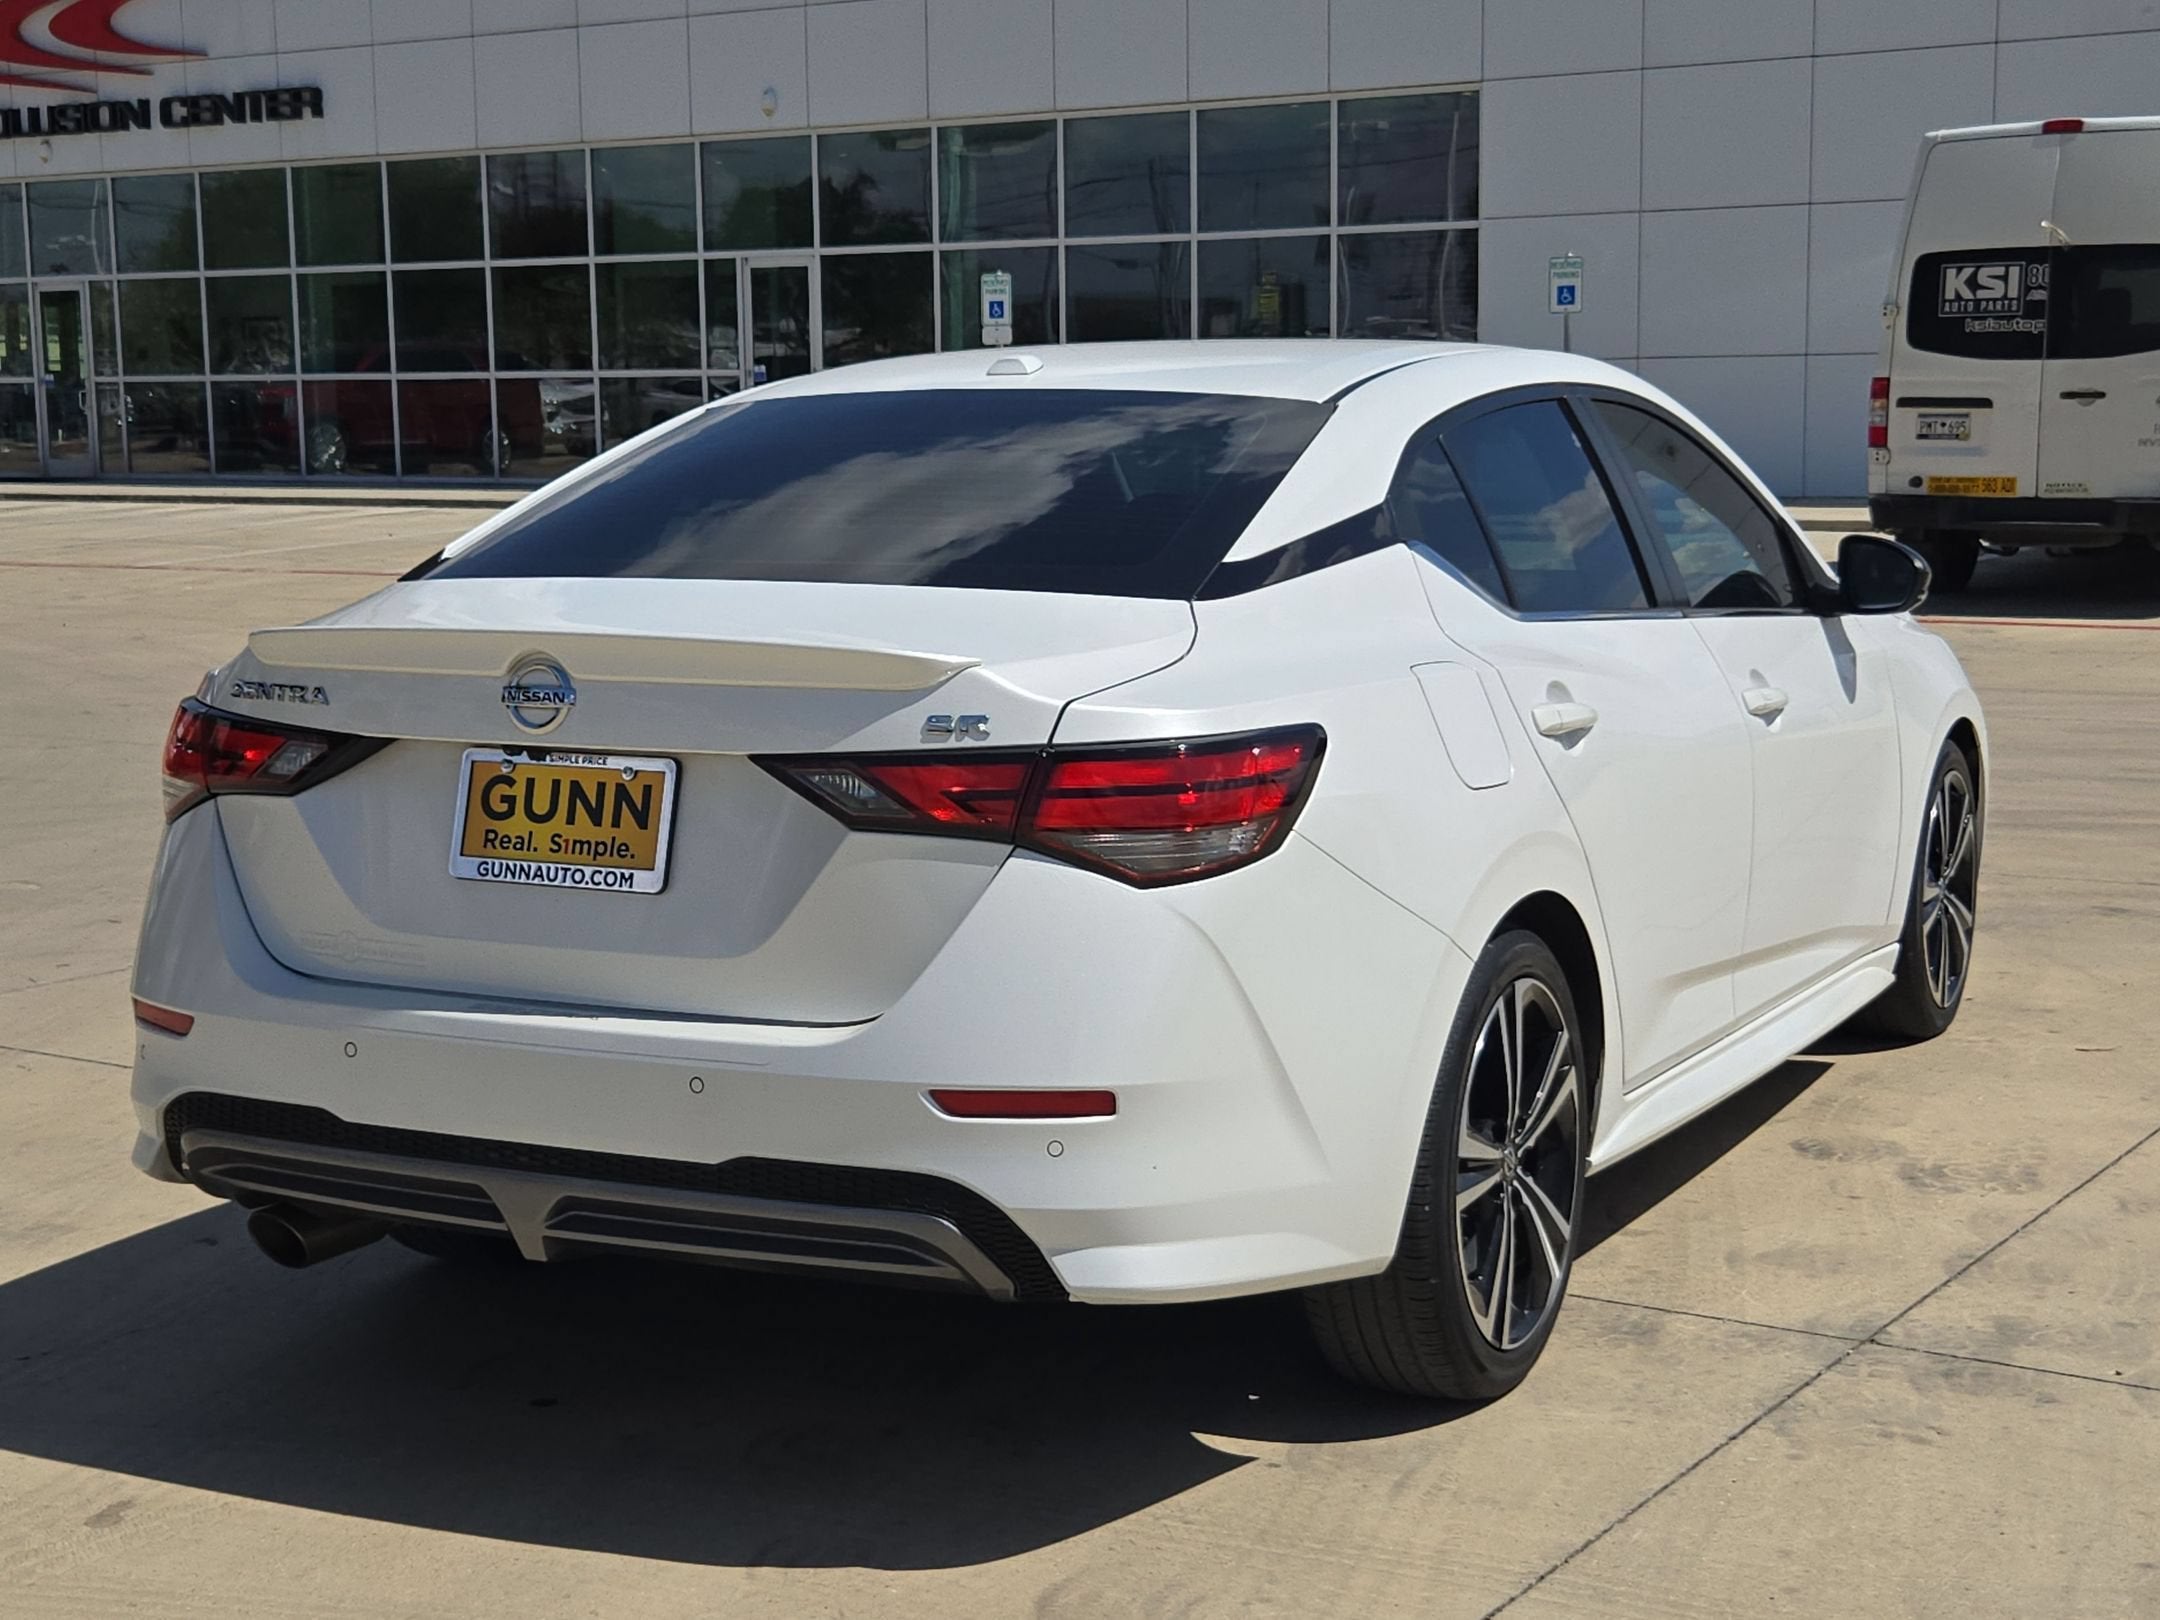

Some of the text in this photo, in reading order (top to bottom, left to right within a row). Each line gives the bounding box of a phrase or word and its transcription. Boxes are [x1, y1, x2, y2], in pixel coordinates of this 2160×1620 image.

[160, 87, 324, 128] CENTER
[1944, 266, 2020, 299] KSI
[1943, 300, 2018, 312] AUTO PARTS
[231, 679, 330, 706] SENTRA
[507, 690, 565, 705] NISSAN
[921, 714, 991, 743] SR
[581, 756, 609, 767] PRICE
[480, 774, 653, 831] GUNN
[483, 828, 538, 852] Real.
[477, 860, 635, 889] GUNNAUTO.COM
